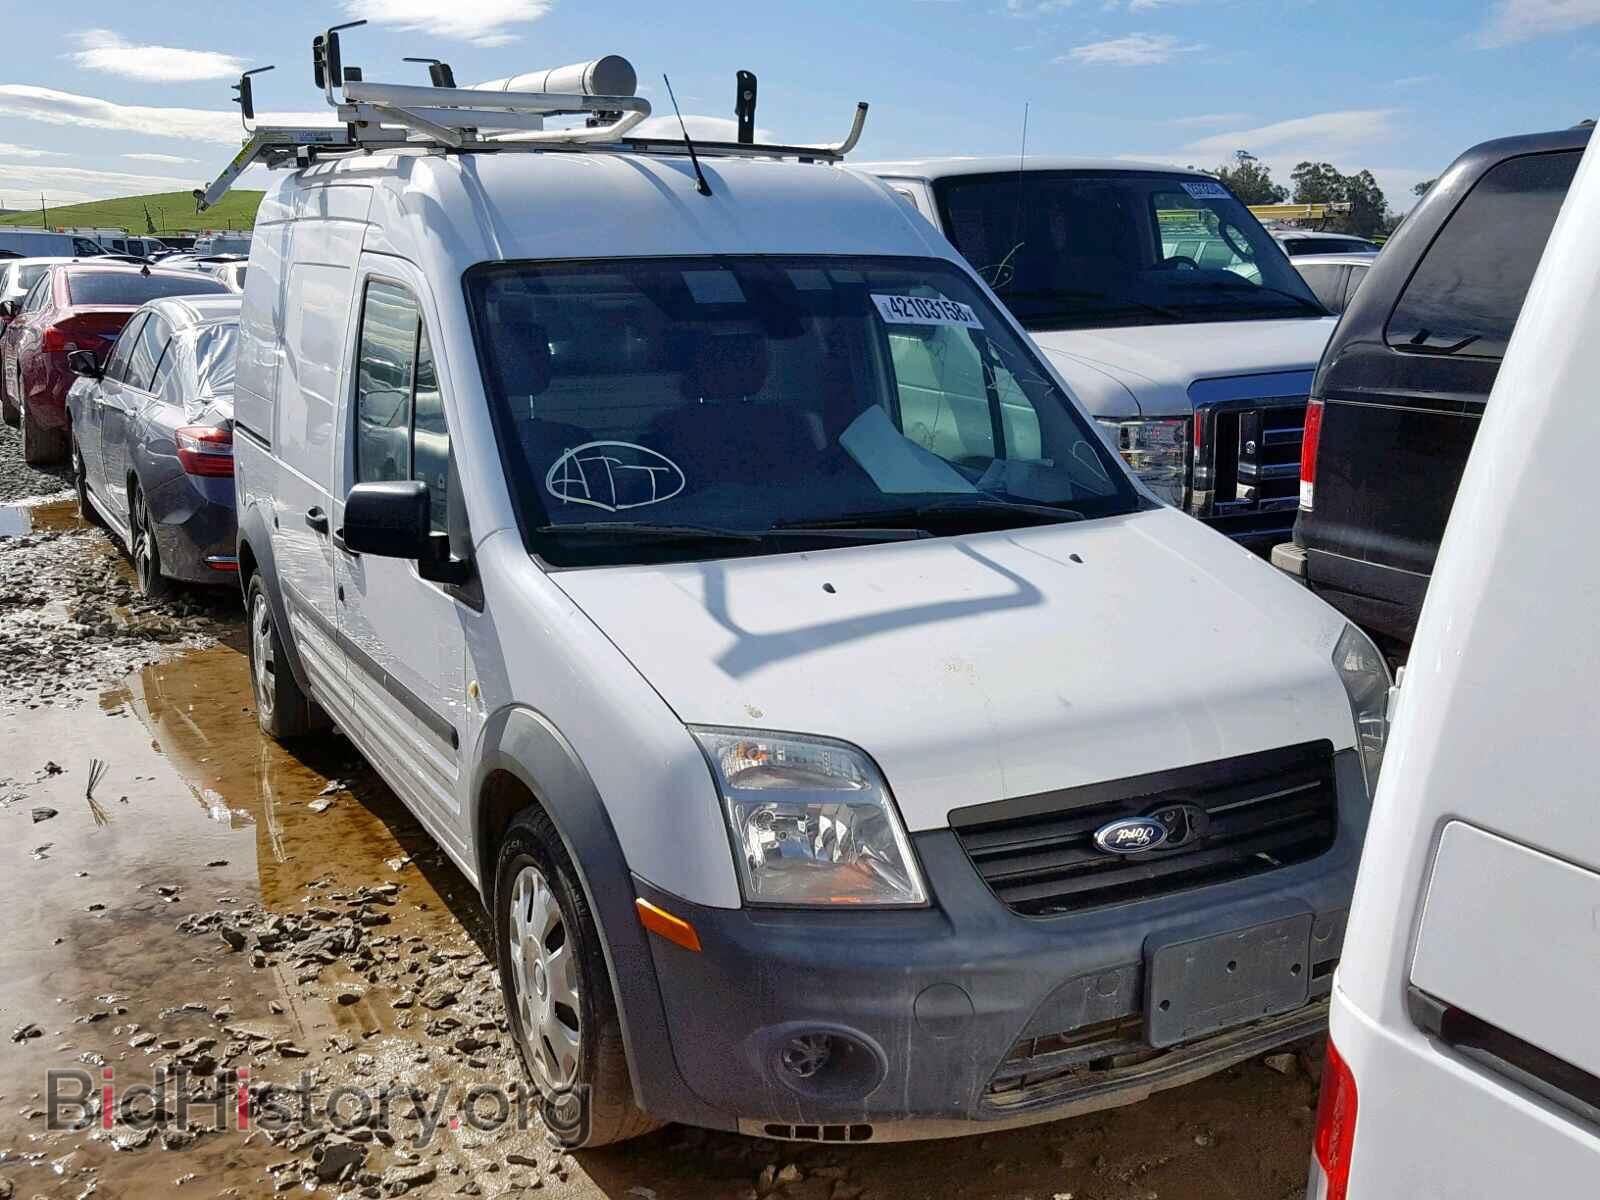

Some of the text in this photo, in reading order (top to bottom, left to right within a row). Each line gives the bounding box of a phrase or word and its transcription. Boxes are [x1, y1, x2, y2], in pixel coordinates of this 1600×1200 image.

[889, 297, 968, 322] 42103158
[552, 449, 669, 503] ATT
[1116, 827, 1154, 846] Ford
